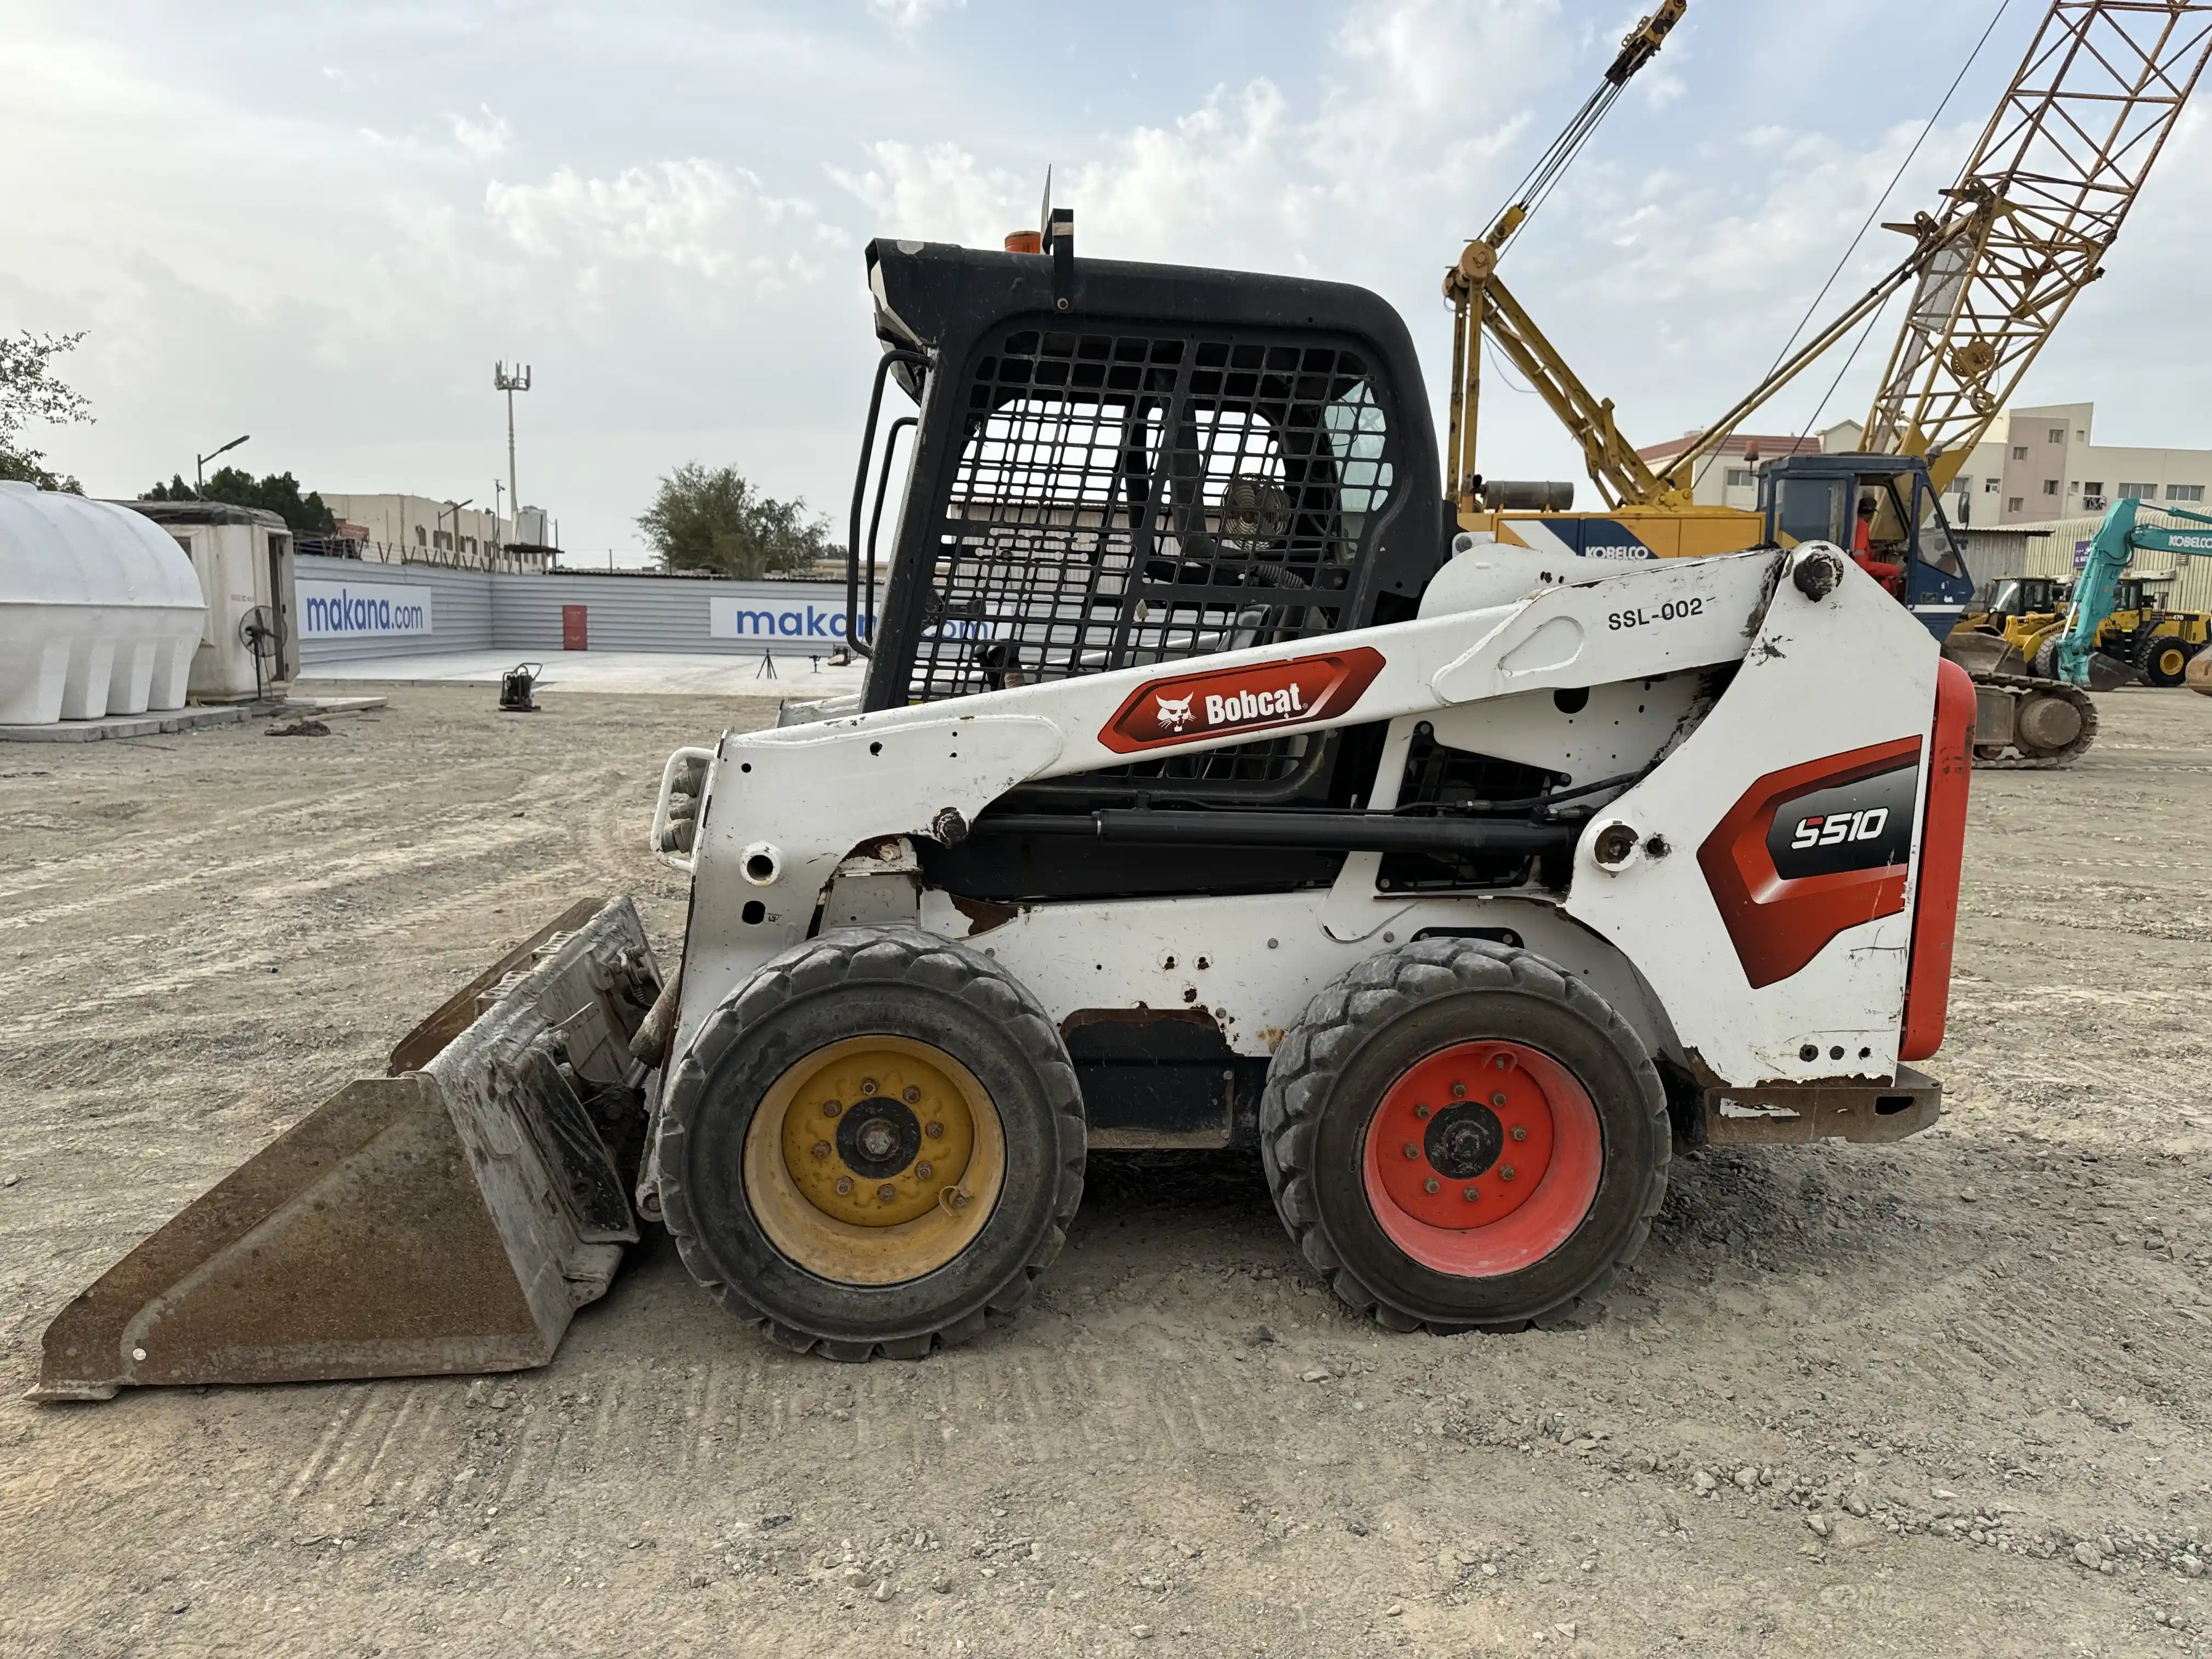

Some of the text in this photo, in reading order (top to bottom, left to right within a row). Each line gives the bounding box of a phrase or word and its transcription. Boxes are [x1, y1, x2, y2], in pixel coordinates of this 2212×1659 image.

[1585, 546, 1648, 560] KOBELCO
[2169, 535, 2212, 549] KOBELCO
[306, 588, 422, 631] makana.com
[1609, 597, 1703, 631] SSL-002
[1205, 683, 1302, 725] Bobcat
[1791, 808, 1889, 849] S510
